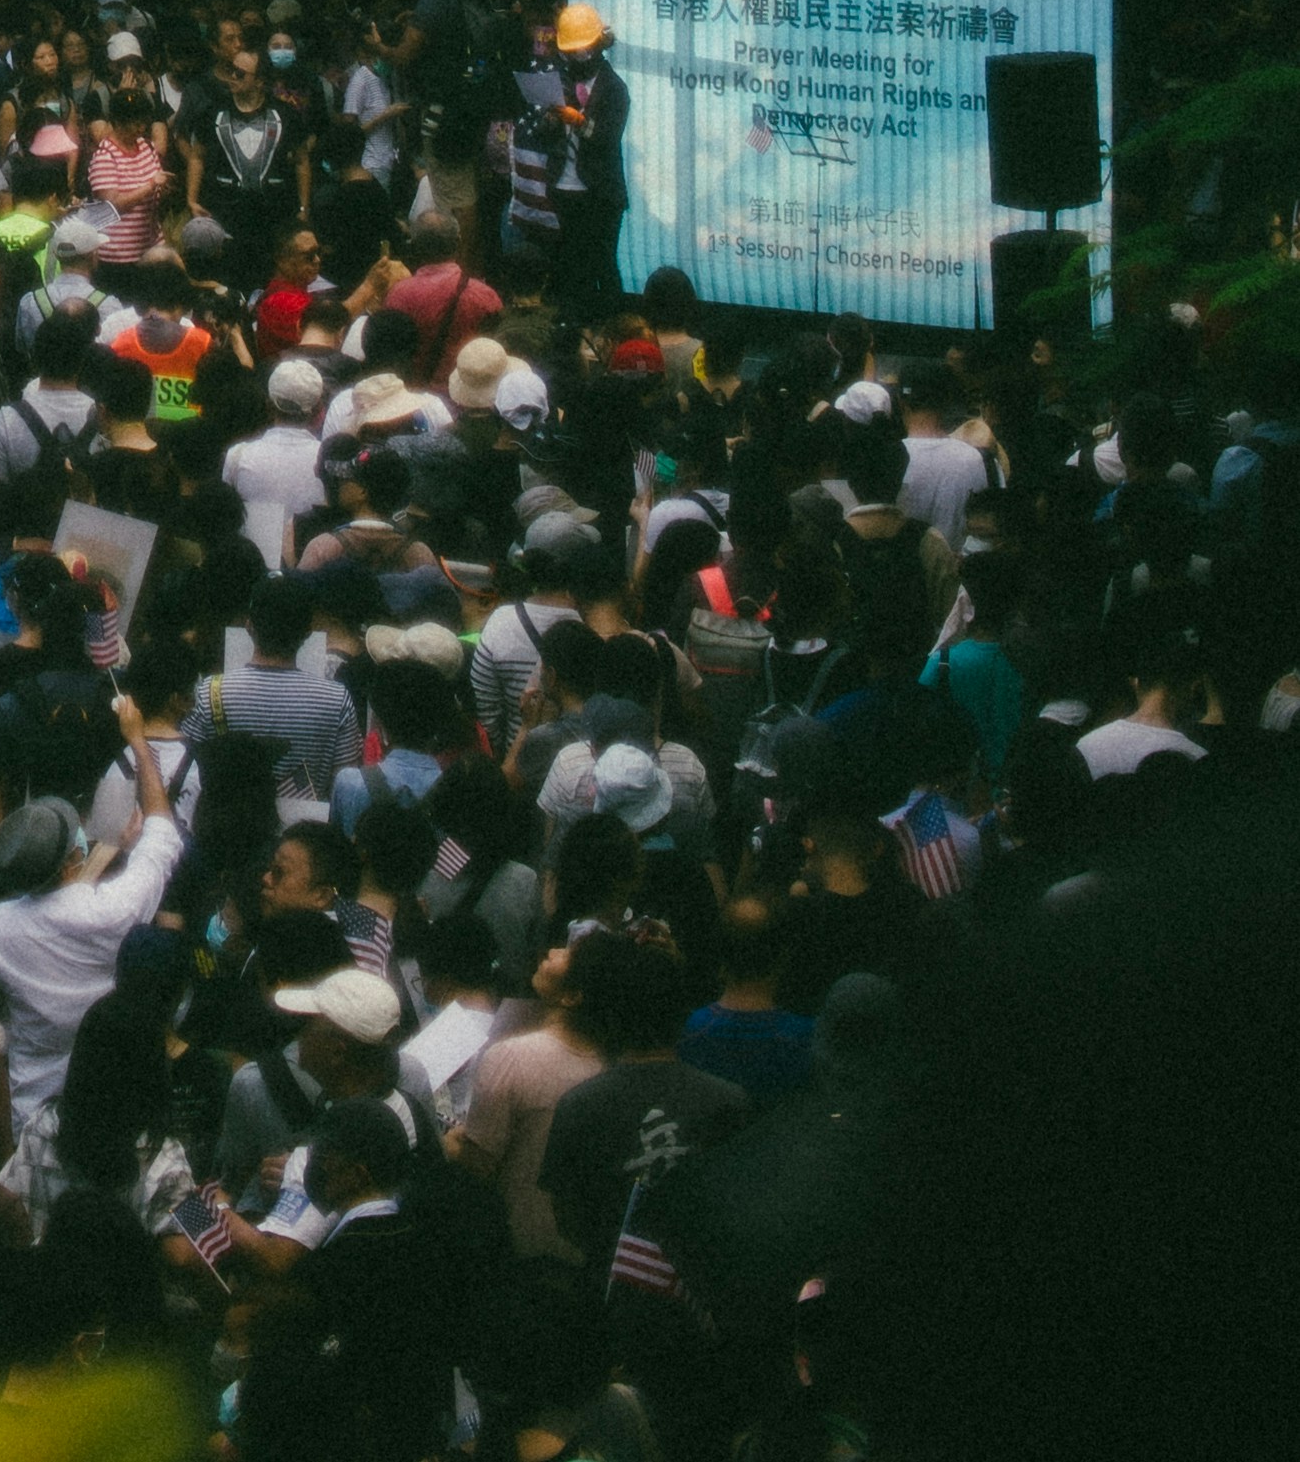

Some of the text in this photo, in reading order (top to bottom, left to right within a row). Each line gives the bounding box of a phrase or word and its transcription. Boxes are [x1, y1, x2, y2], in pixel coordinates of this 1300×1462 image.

[734, 40, 934, 79] Prayer Meeting for
[670, 67, 986, 112] Hong Kong Human Rights an
[753, 103, 918, 138] Democracy Act
[708, 233, 730, 254] 1st
[735, 237, 803, 262] Session
[826, 245, 894, 270] Chosen
[900, 251, 964, 277] People
